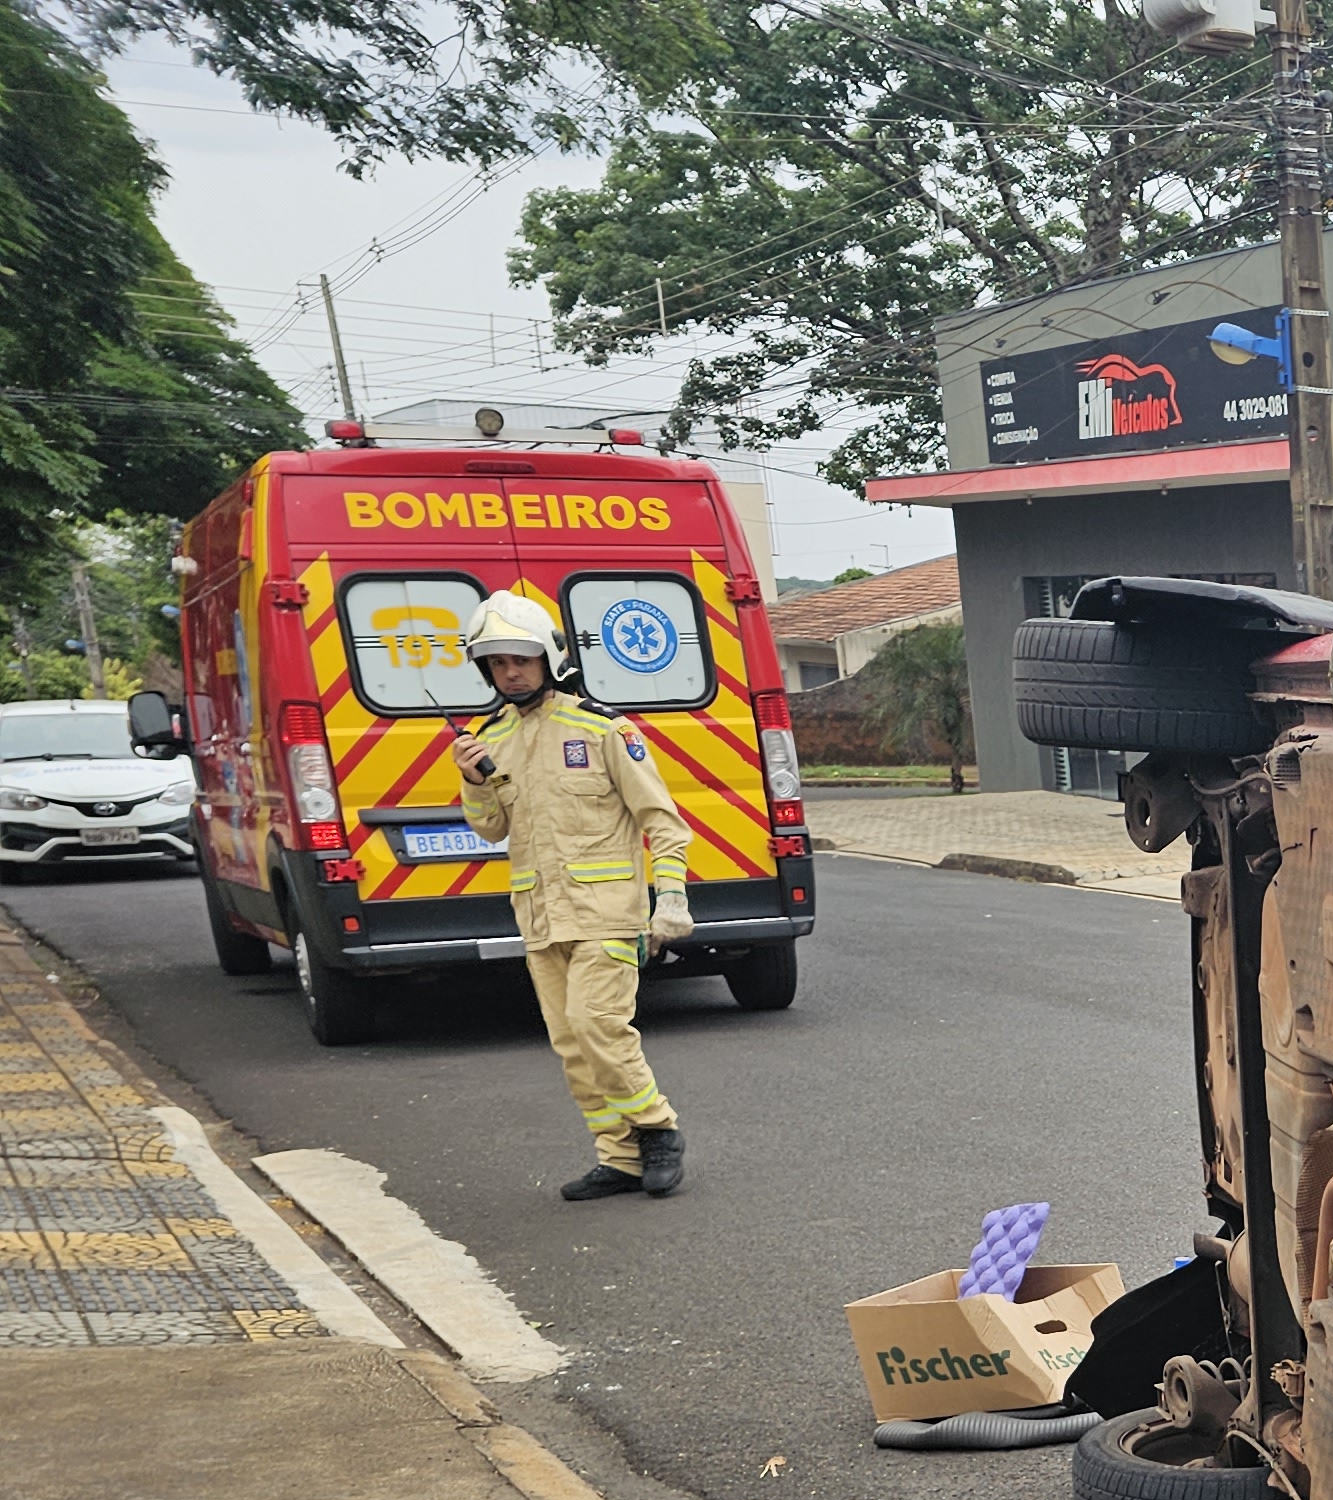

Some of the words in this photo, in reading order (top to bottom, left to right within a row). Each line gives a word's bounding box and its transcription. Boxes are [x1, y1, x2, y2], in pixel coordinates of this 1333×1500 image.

[991, 371, 1016, 387] COMPRA
[994, 412, 1015, 425] TROCA
[1223, 400, 1238, 421] 44
[1239, 394, 1288, 420] 3029-081
[344, 492, 671, 531] BOMBEIROS
[604, 603, 626, 627] SIATE
[380, 634, 464, 668] 193
[416, 834, 495, 853] BEA8D4
[876, 1346, 1010, 1386] Fischer
[1038, 1346, 1087, 1370] Fisch
